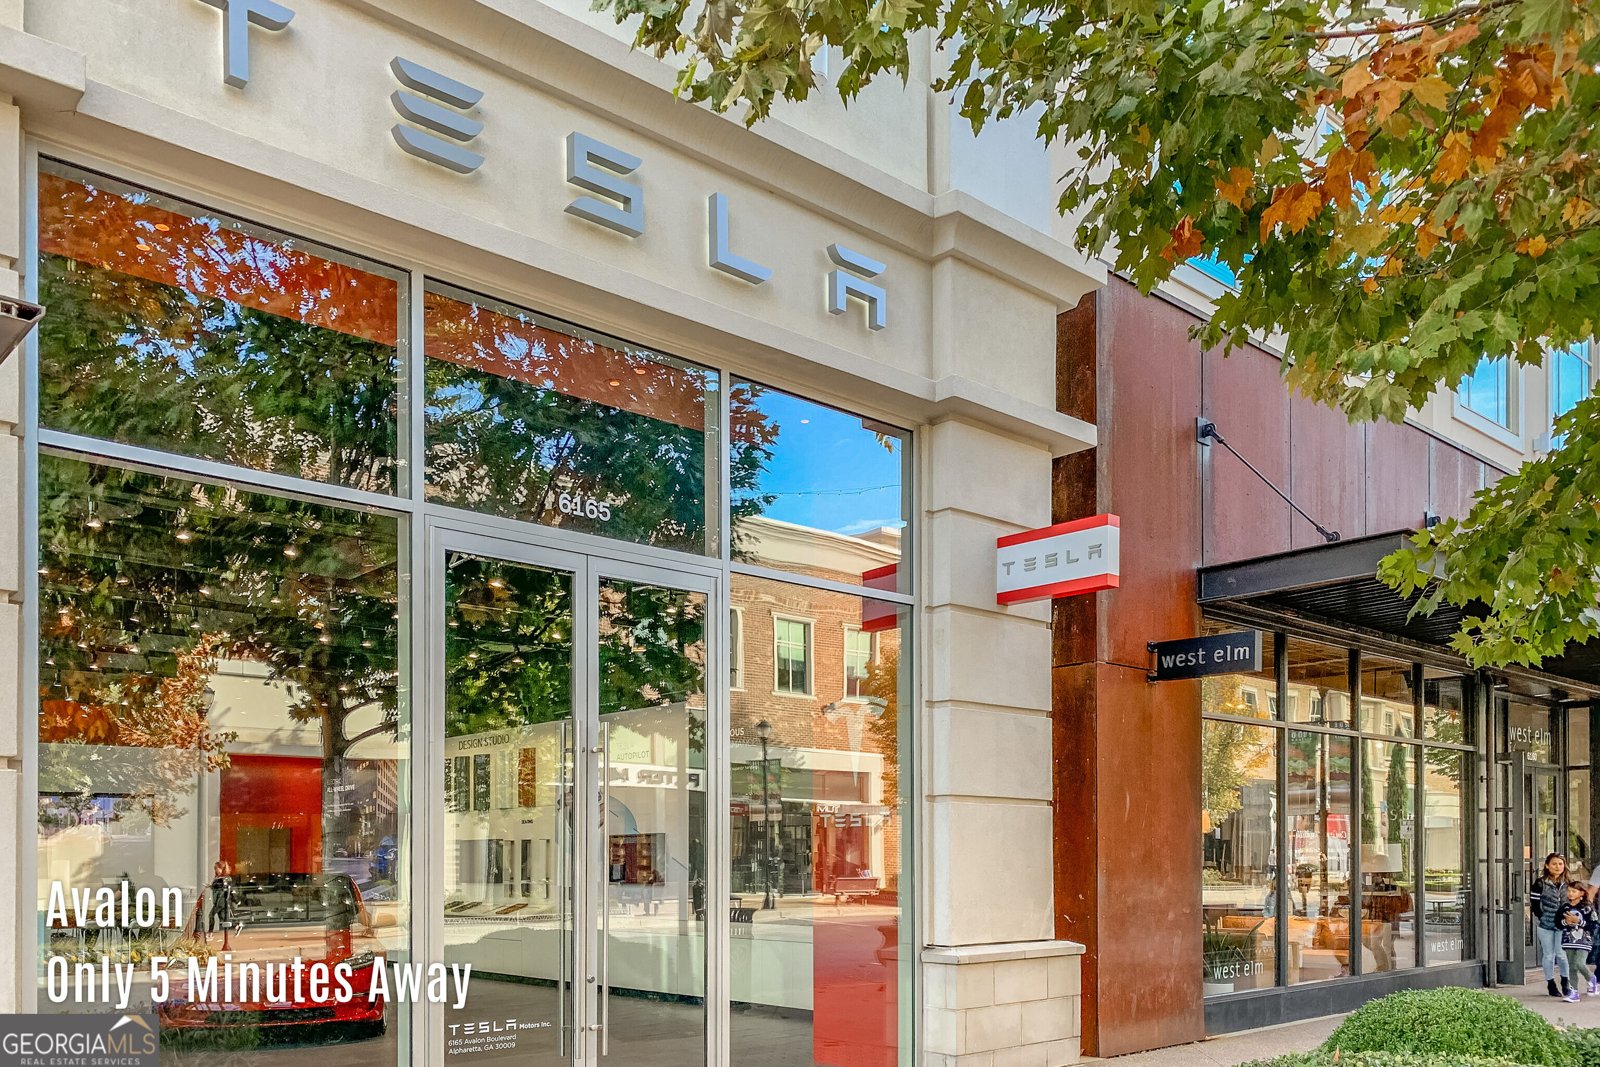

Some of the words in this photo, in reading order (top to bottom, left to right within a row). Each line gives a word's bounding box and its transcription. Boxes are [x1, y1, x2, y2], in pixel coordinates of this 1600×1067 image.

[199, 0, 887, 331] TESLA
[559, 493, 611, 521] 6165
[1001, 543, 1103, 576] TESLA
[1161, 648, 1206, 669] west
[1213, 644, 1250, 663] elm
[458, 739, 483, 751] DESIGN
[483, 734, 510, 747] STUDIO
[1509, 725, 1532, 744] west
[1534, 727, 1552, 746] elm
[616, 750, 650, 761] AUTOPILOT
[1429, 940, 1449, 953] west
[1449, 937, 1464, 951] elm
[1213, 962, 1241, 980] west
[1243, 960, 1264, 977] elm
[448, 1019, 517, 1036] TESLA
[519, 1022, 540, 1030] Motors
[541, 1020, 552, 1028] Inc.
[448, 1038, 463, 1047] 6165
[463, 1036, 486, 1045] Avalon
[486, 1034, 517, 1043] Boulevard
[448, 1045, 483, 1056] Alpharetta,
[495, 1041, 516, 1050] 30009
